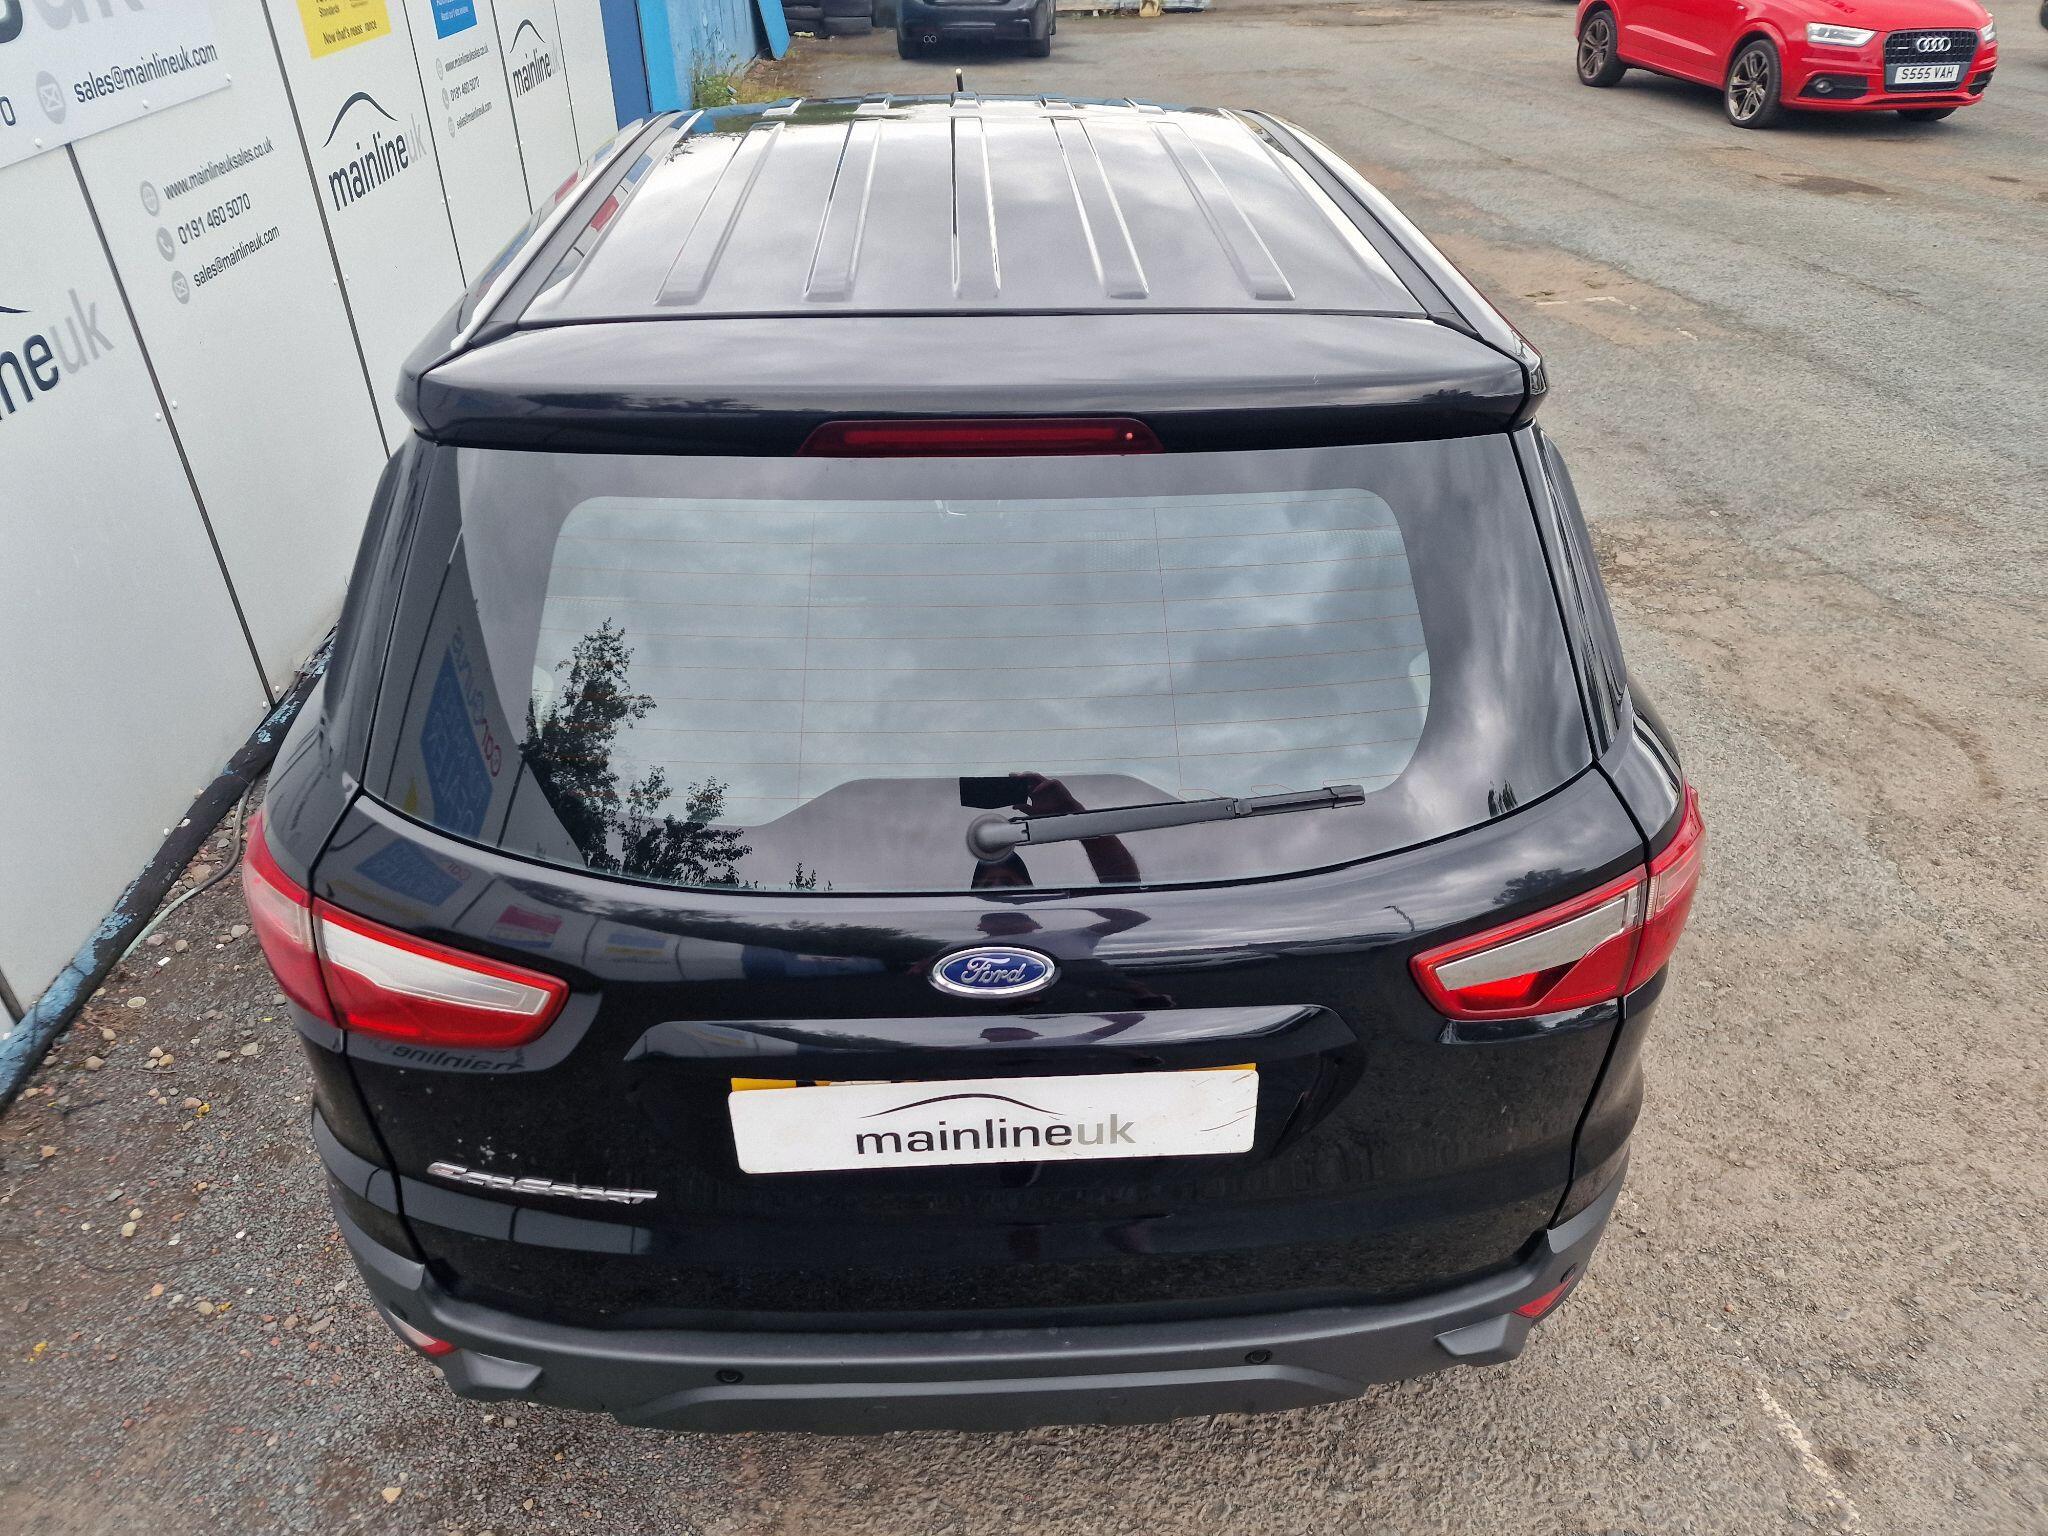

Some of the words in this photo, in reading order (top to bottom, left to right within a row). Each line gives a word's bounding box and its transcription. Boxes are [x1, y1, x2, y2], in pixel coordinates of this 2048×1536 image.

[73, 43, 218, 103] sales@mainlineuk.com
[1901, 67, 1932, 80] S555
[163, 136, 275, 200] www.mainlineuksales.co.uk
[328, 113, 427, 211] mainlineuk
[177, 216, 207, 245] 0191
[206, 206, 227, 229] 460
[225, 193, 251, 219] 5070
[193, 225, 281, 287] sales@mainlineuk.com
[960, 955, 1026, 985] Ford
[855, 1113, 1137, 1156] mainlineuk
